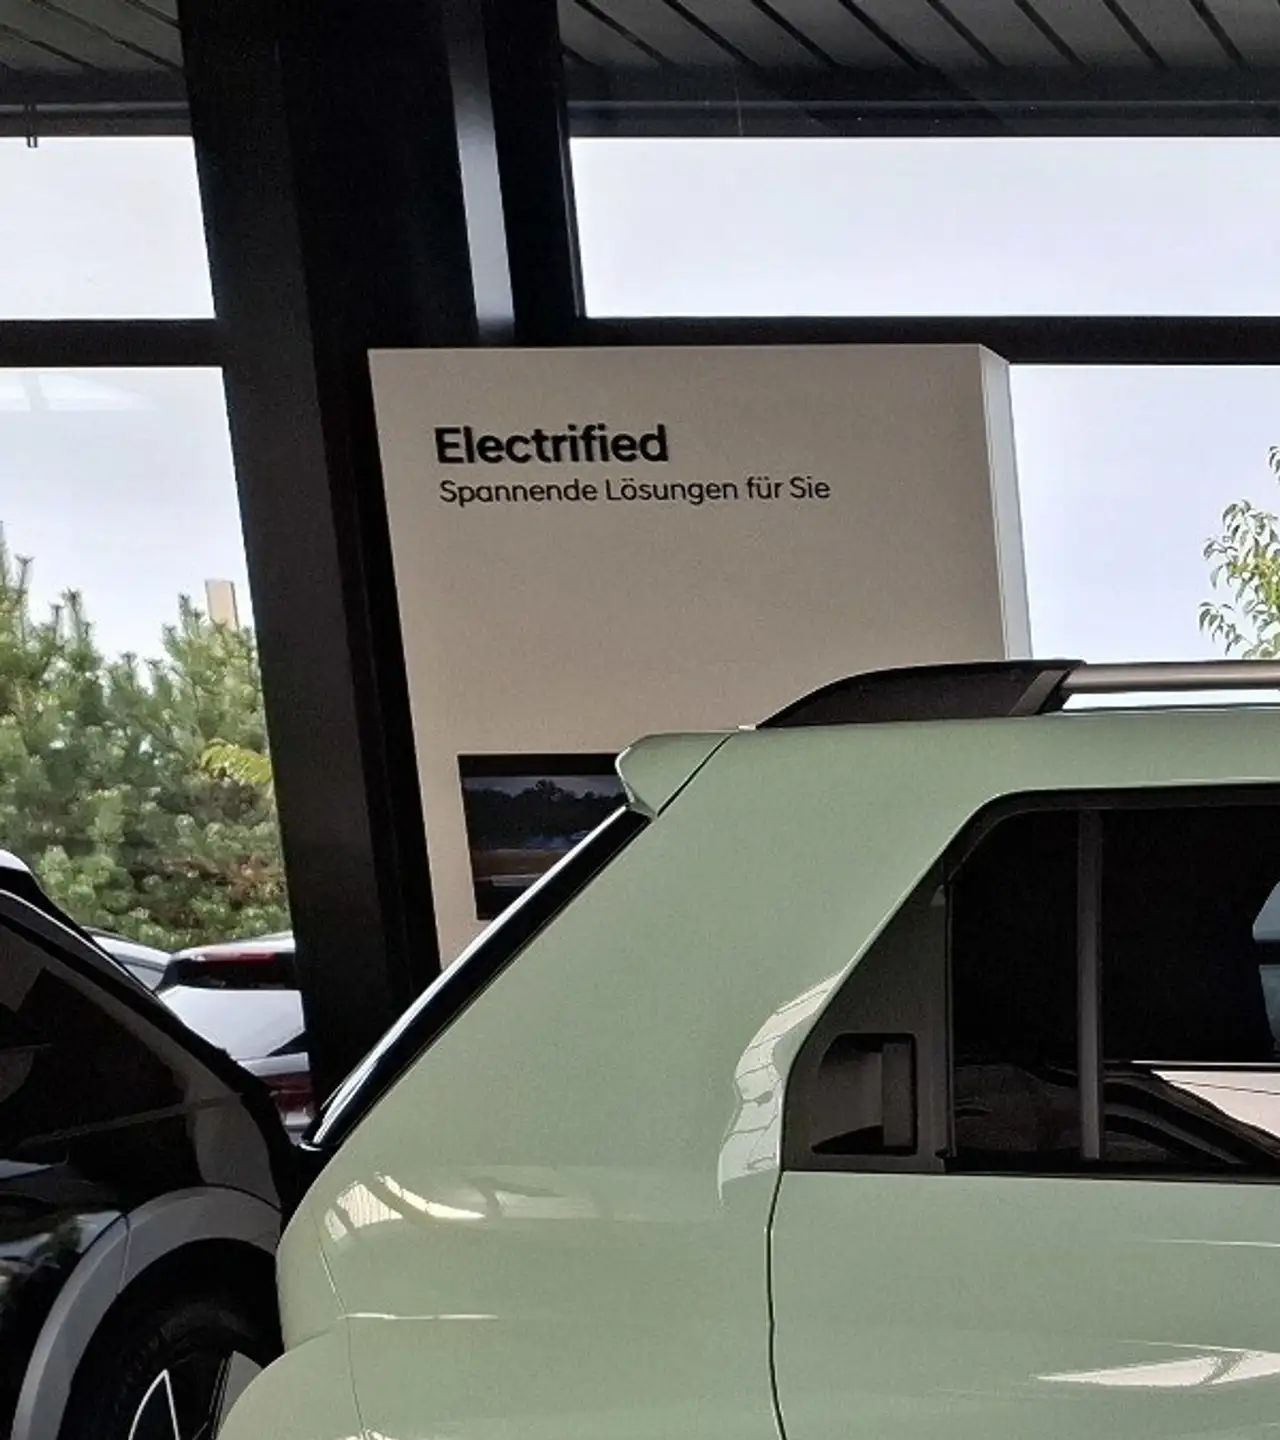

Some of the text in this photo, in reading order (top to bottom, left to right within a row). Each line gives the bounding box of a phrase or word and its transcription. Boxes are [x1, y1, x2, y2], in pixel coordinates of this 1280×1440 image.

[433, 423, 669, 463] Electrified
[439, 474, 832, 508] Spannende Lösungen für Sie
